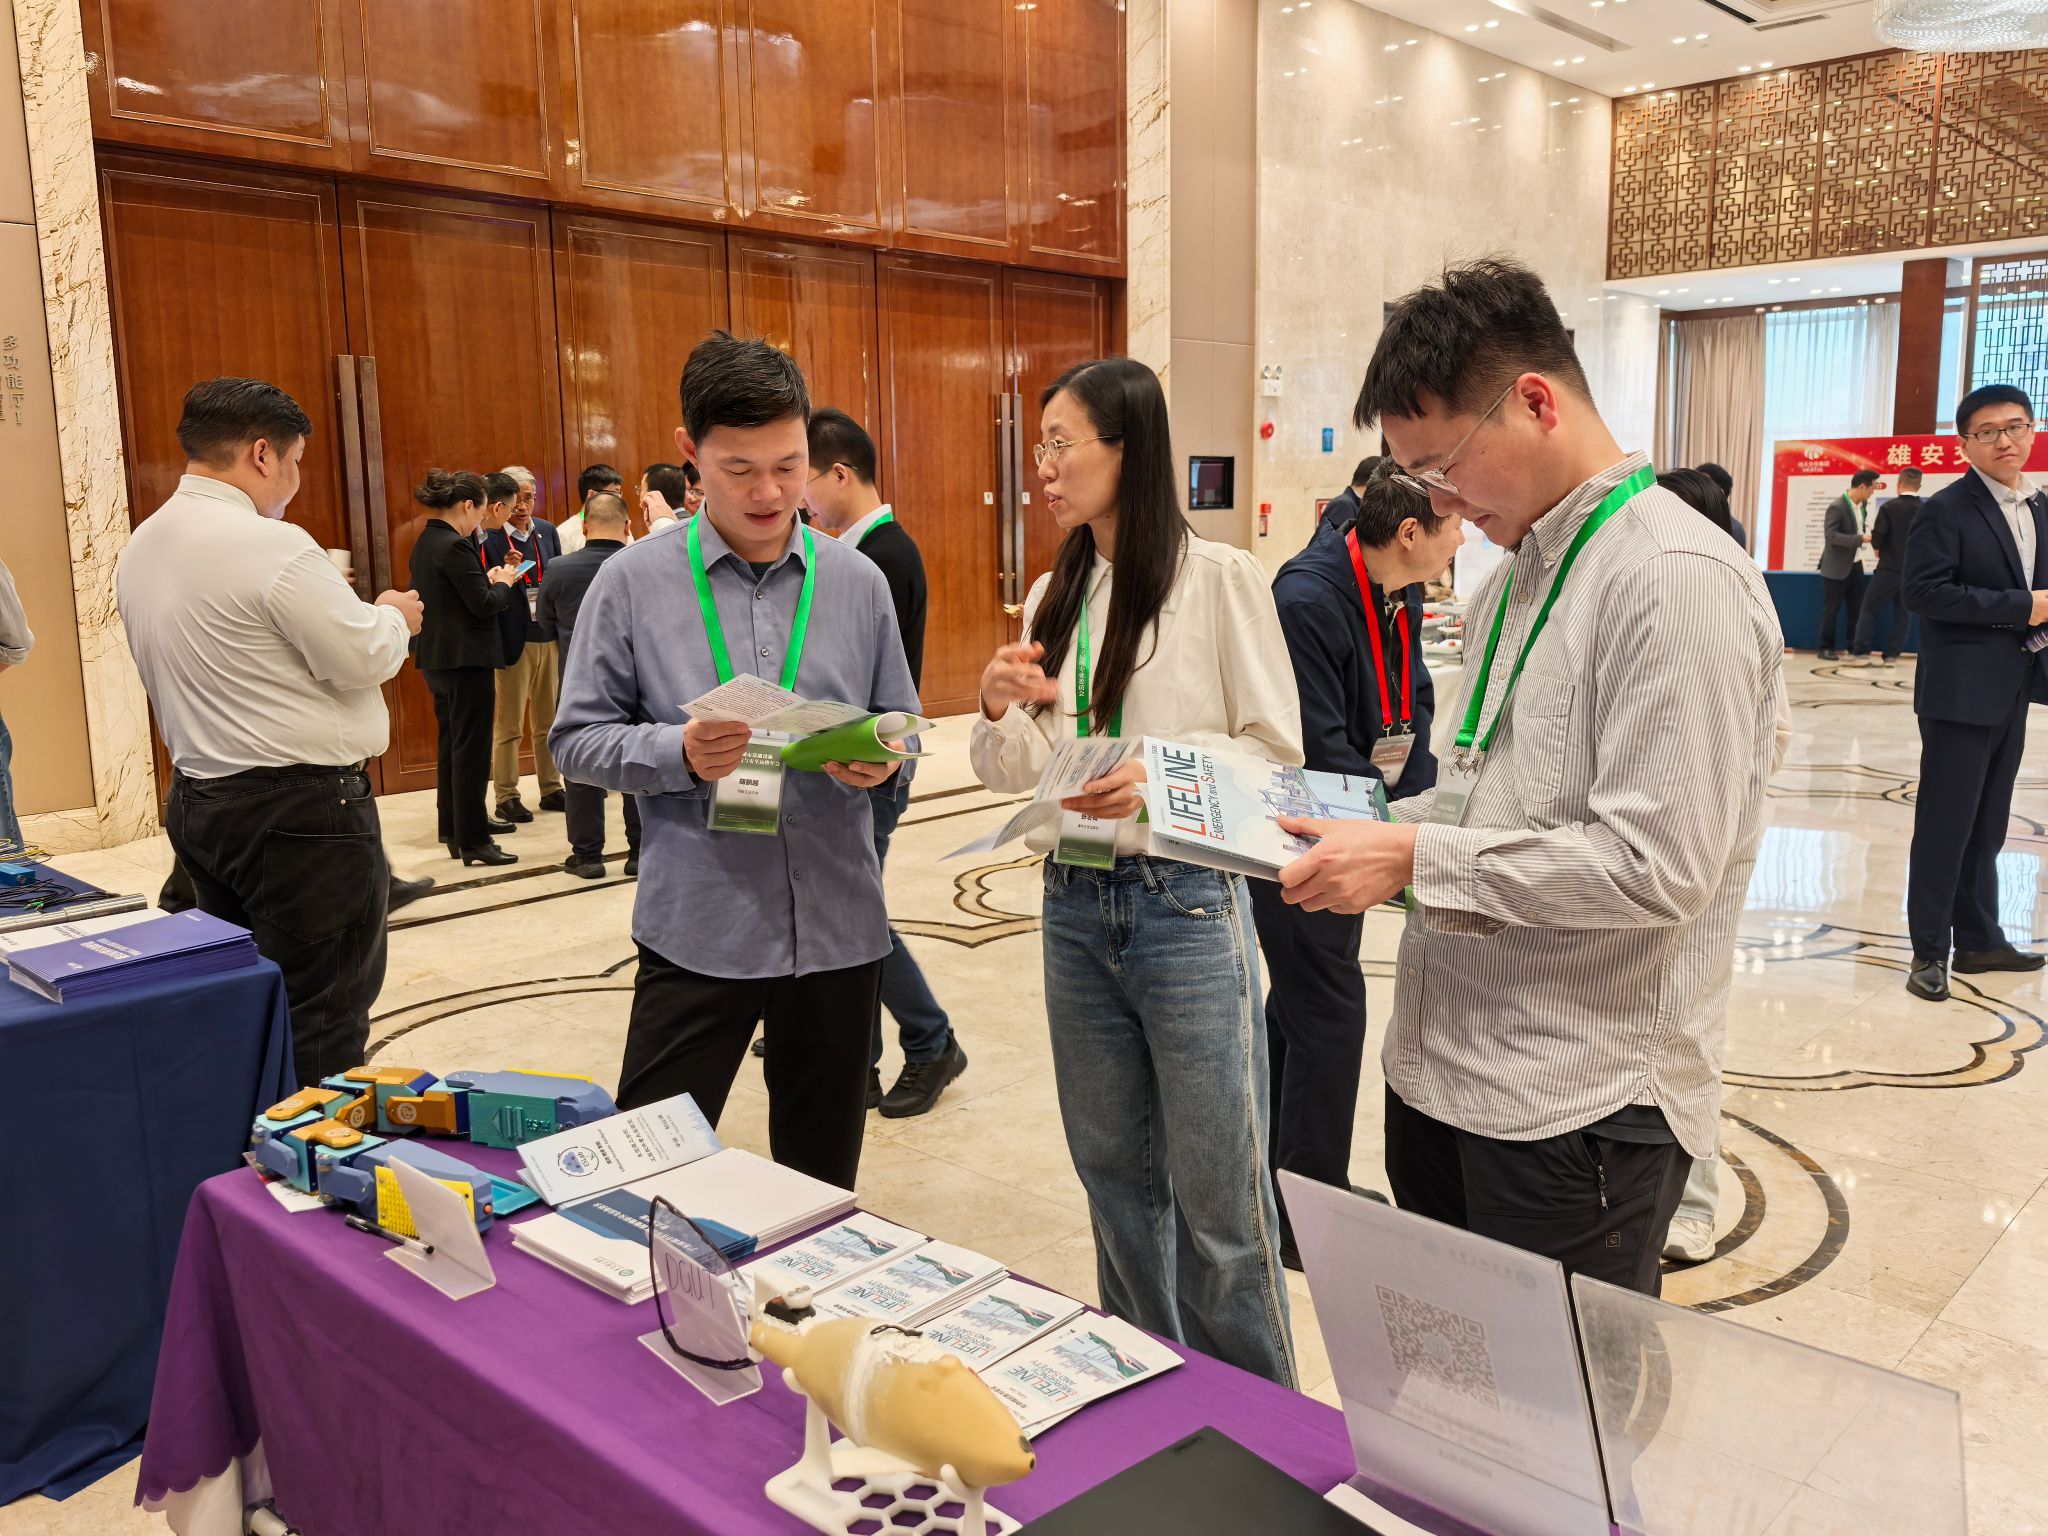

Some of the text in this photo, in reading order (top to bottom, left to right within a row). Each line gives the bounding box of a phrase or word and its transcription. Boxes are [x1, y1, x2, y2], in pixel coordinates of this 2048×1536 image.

[1162, 747, 1206, 836] LIFELINE
[1200, 753, 1225, 840] EMERGENCY and SAFETY
[776, 1256, 833, 1280] LIFELINE
[847, 1286, 906, 1313] LIFELINE
[928, 1330, 990, 1357] LIFELINE
[1008, 1366, 1068, 1402] LIFELINE
